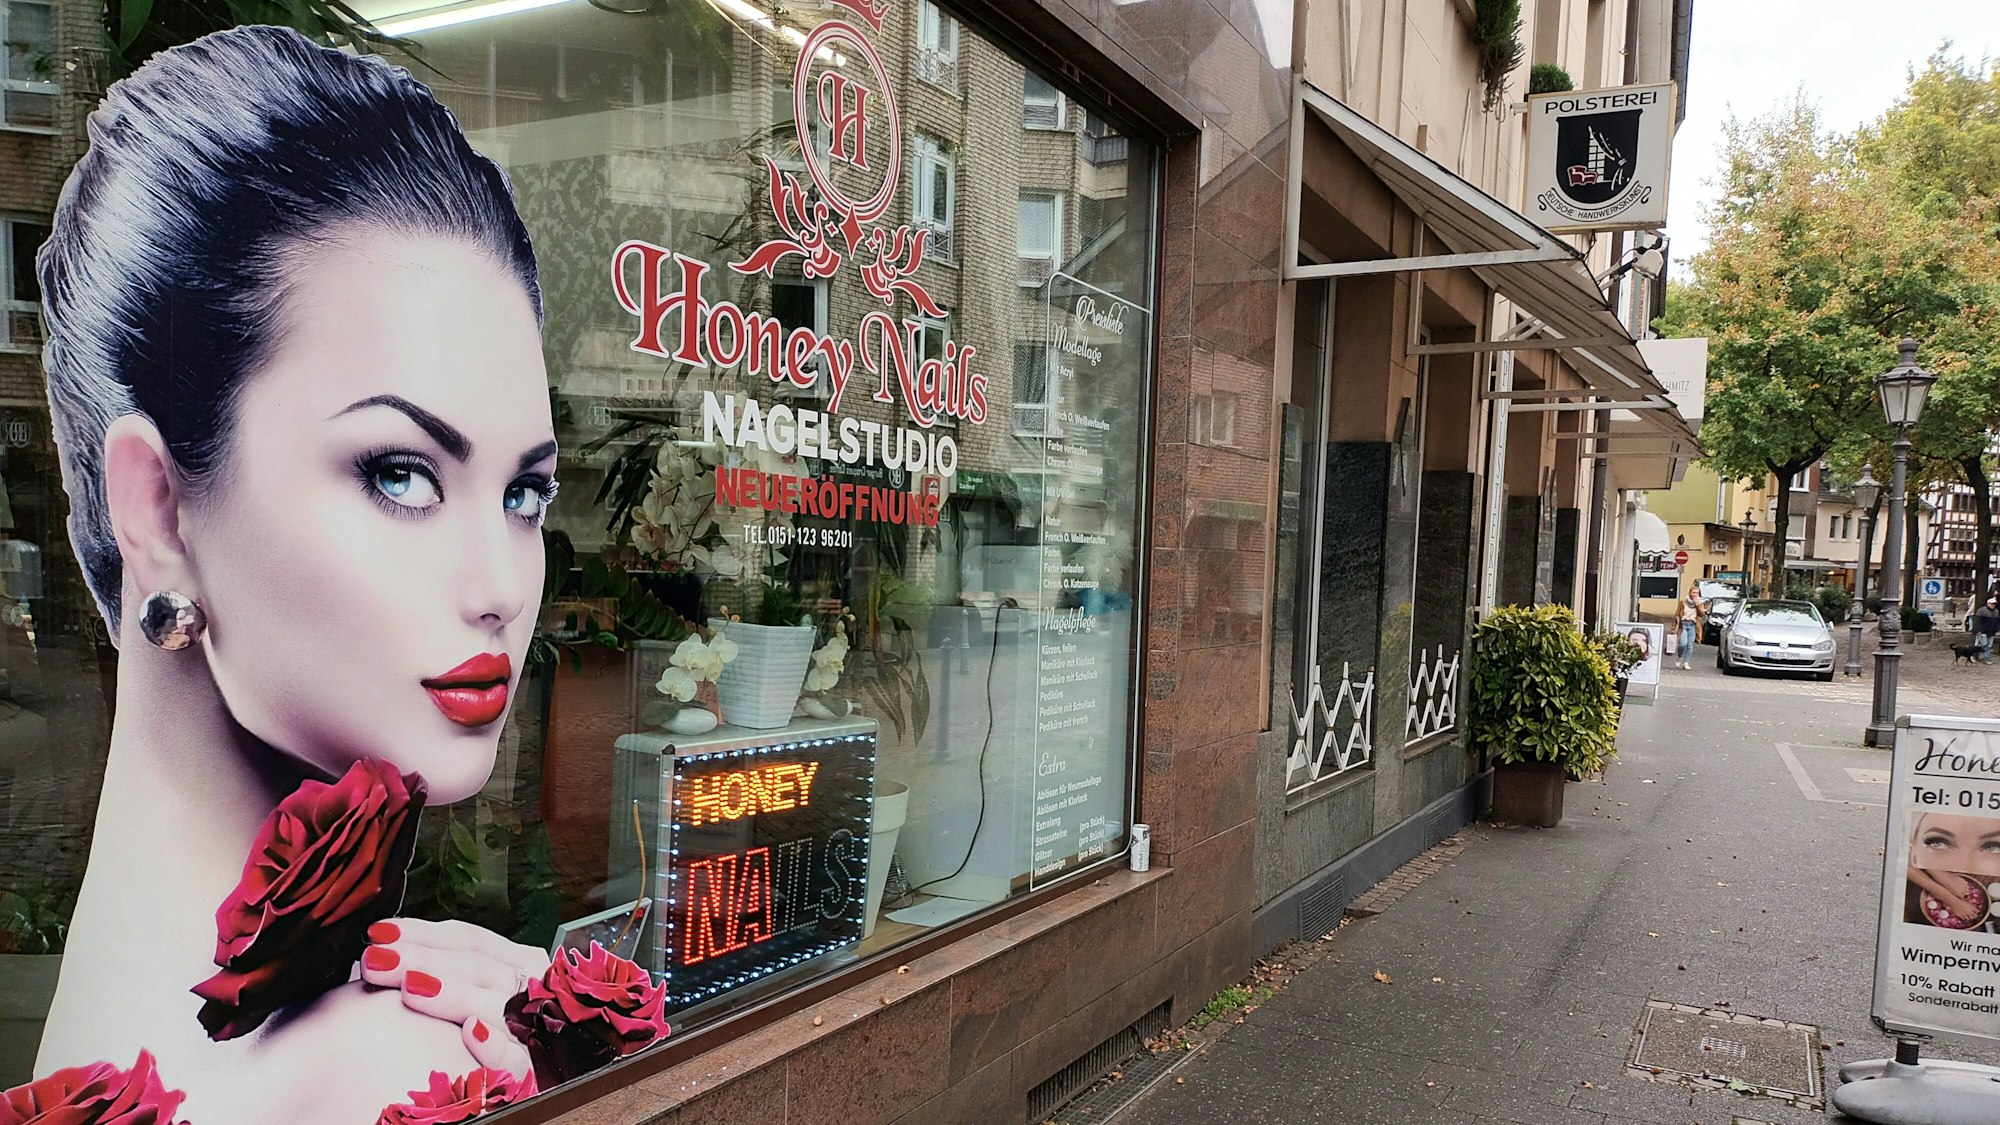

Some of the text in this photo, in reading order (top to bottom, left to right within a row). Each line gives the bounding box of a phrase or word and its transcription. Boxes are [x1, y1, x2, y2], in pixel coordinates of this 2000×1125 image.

[1545, 91, 1657, 114] POLSTEREI
[816, 70, 871, 171] H
[1545, 184, 1643, 219] DEUTSCHE HANDWERKSKUNST
[1074, 295, 1129, 335] Preisliste
[610, 239, 989, 428] Honey Nails
[1052, 322, 1102, 366] Modellage
[704, 391, 958, 478] NAGELSTUDIO
[1047, 439, 1088, 456] Farbe verlaufen
[715, 464, 940, 527] NEUERÖFFNUNG
[1045, 515, 1061, 527] Natur
[821, 528, 853, 549] 96201
[1045, 531, 1063, 543] French
[1044, 547, 1060, 558] Farbe
[1044, 562, 1084, 574] Farbe verlaufen
[1042, 605, 1096, 635] Nagelpflege
[1041, 642, 1077, 655] Kürzen, feilen
[1041, 659, 1065, 670] Maniküre
[1066, 657, 1075, 668] mit
[1041, 674, 1065, 686] Maniküre
[1066, 672, 1075, 682] mit
[1040, 689, 1063, 701] Pediküre
[1040, 704, 1063, 717] Pediküre
[1063, 702, 1072, 712] mit
[1039, 714, 1089, 732] Pediküre mit french
[1038, 752, 1066, 777] Extra
[692, 761, 819, 826] HONEY
[1036, 788, 1059, 801] Ablösen
[1059, 784, 1067, 795] für
[1036, 792, 1088, 816] Ablösen mit Klarlack
[1912, 786, 2000, 810] Tel: 015
[1036, 816, 1061, 831] Extralang
[1079, 821, 1090, 833] (pro
[1089, 814, 1105, 828] Stück)
[1034, 828, 1104, 862] Glitzer (pro Stück)
[1034, 842, 1104, 878] Handdesign (pro Stück)
[684, 828, 855, 965] NAILS
[1950, 940, 2000, 956] Wir ma
[1901, 973, 1995, 998] 10% Rabatt
[1908, 991, 1999, 1015] Sonderrabatt
